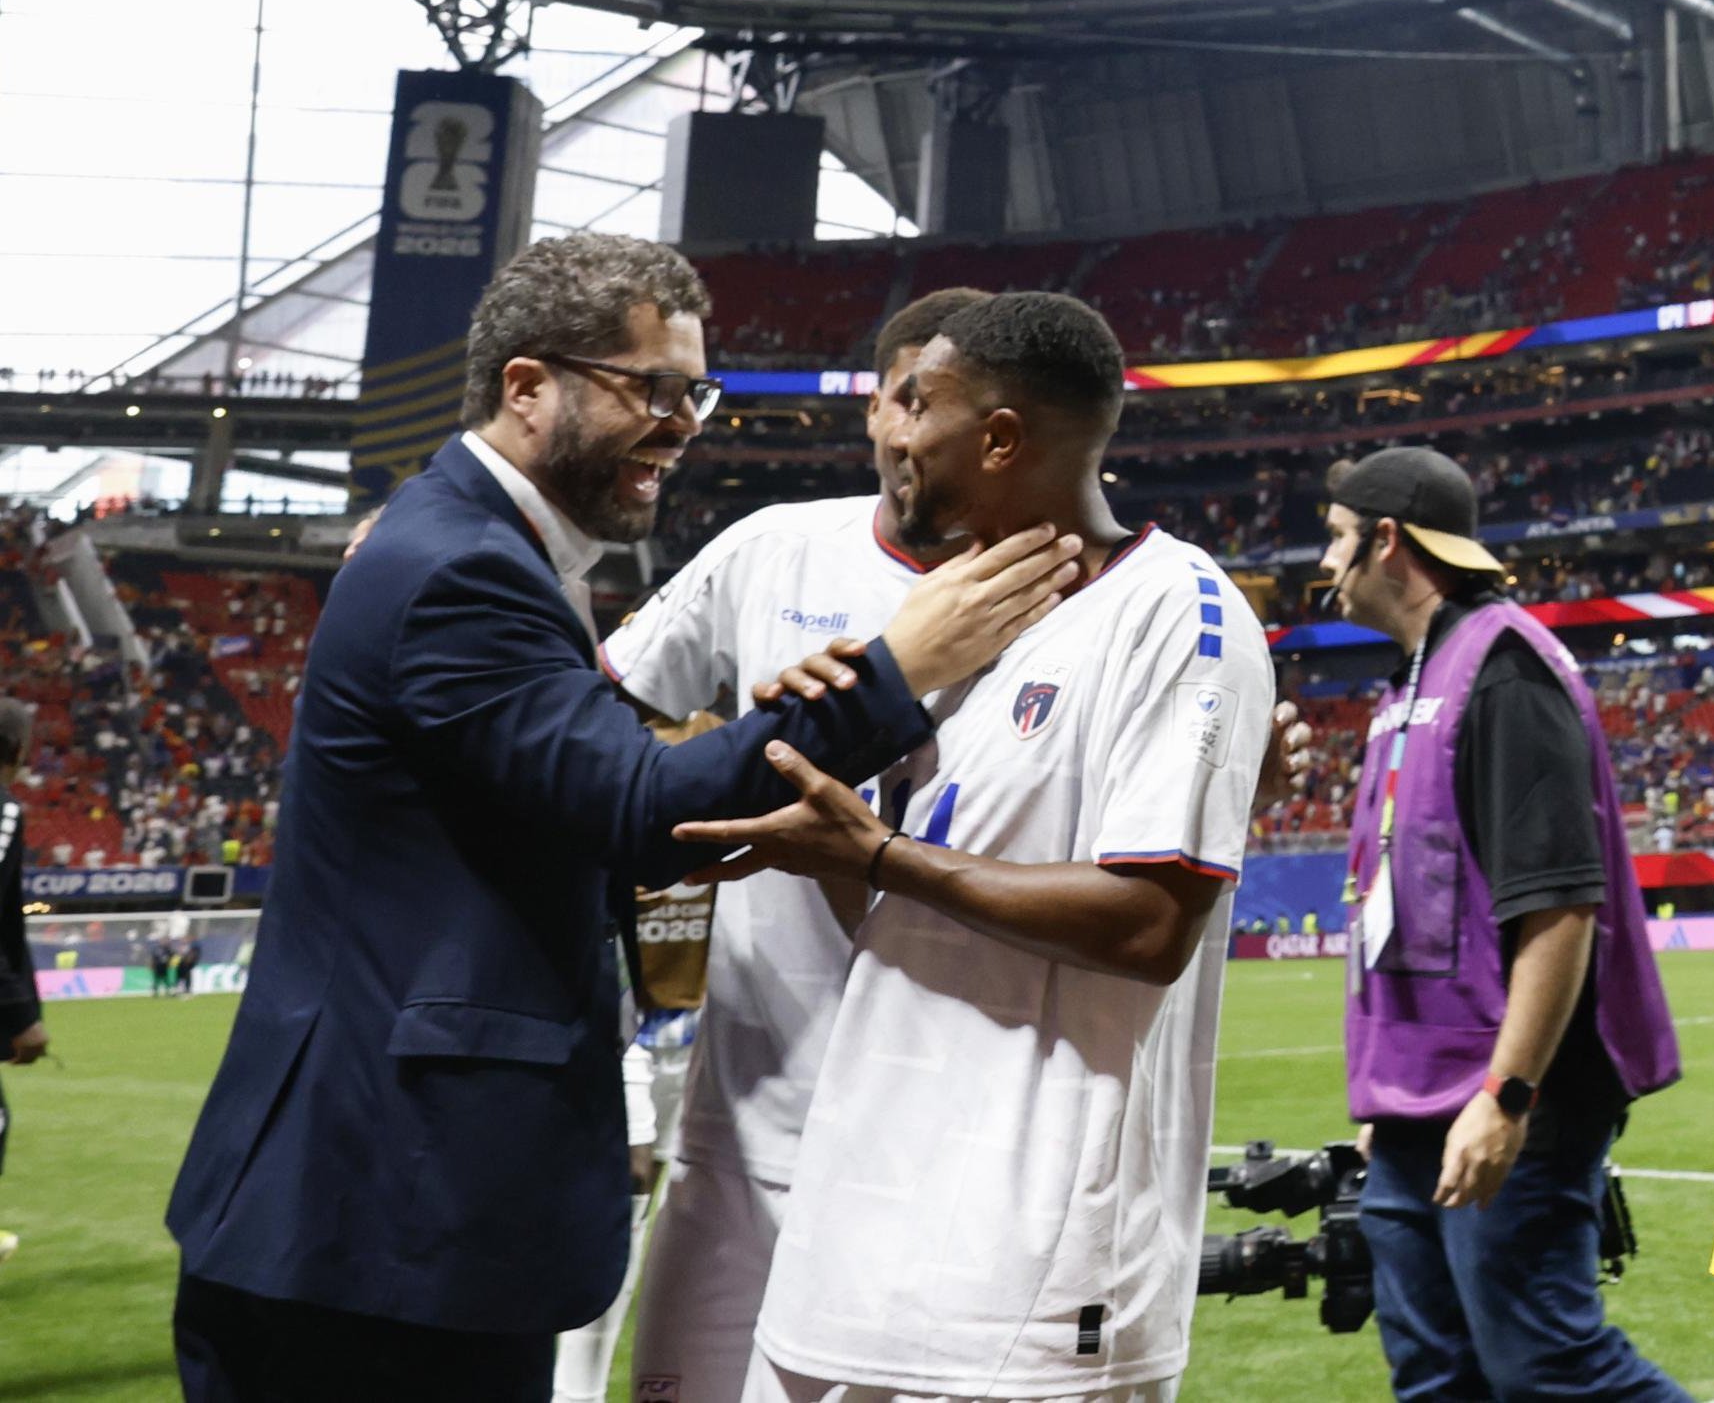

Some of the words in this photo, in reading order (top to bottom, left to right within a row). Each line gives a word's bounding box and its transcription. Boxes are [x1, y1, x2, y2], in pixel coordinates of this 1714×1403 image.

[781, 608, 849, 630] capelli
[32, 873, 86, 895] CUP
[86, 871, 178, 894] 2026
